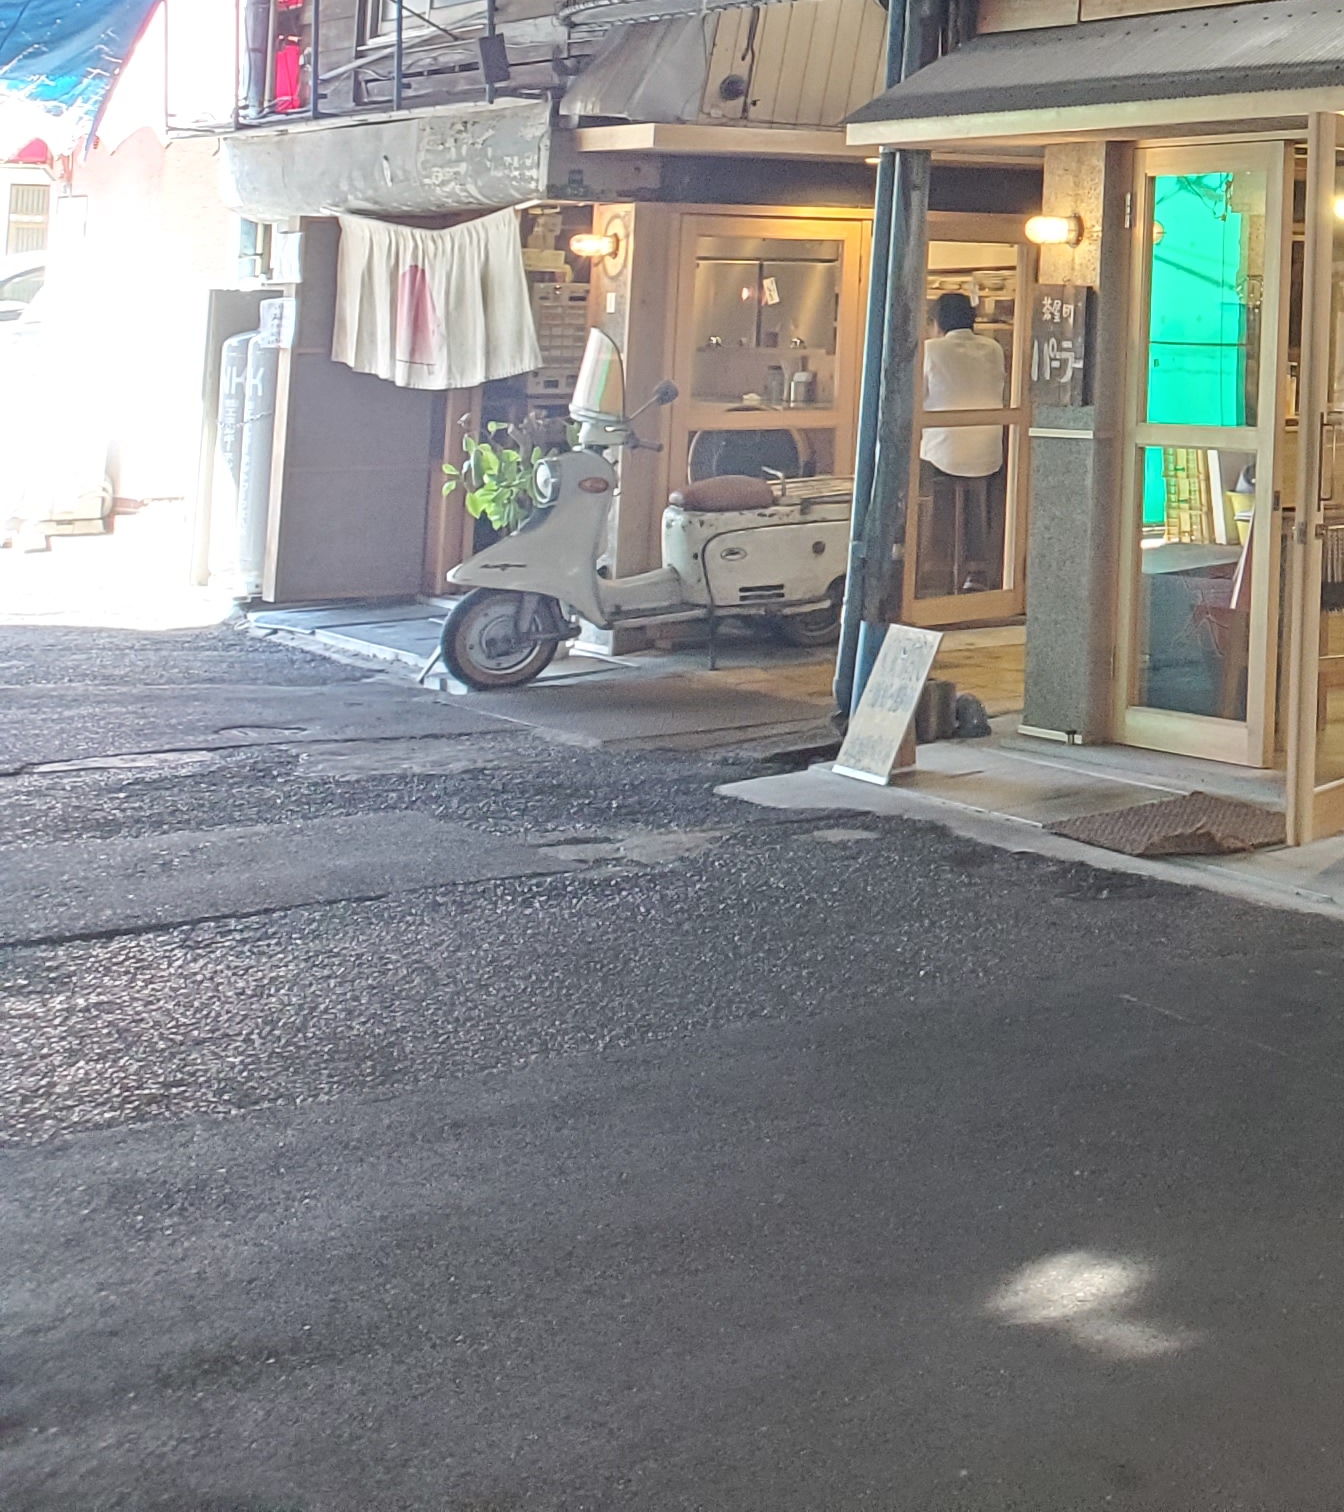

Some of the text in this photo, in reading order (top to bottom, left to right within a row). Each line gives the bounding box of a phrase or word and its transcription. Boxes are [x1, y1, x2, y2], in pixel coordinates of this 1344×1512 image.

[1042, 295, 1074, 328] 茶屋町
[1031, 337, 1084, 383] パーラー
